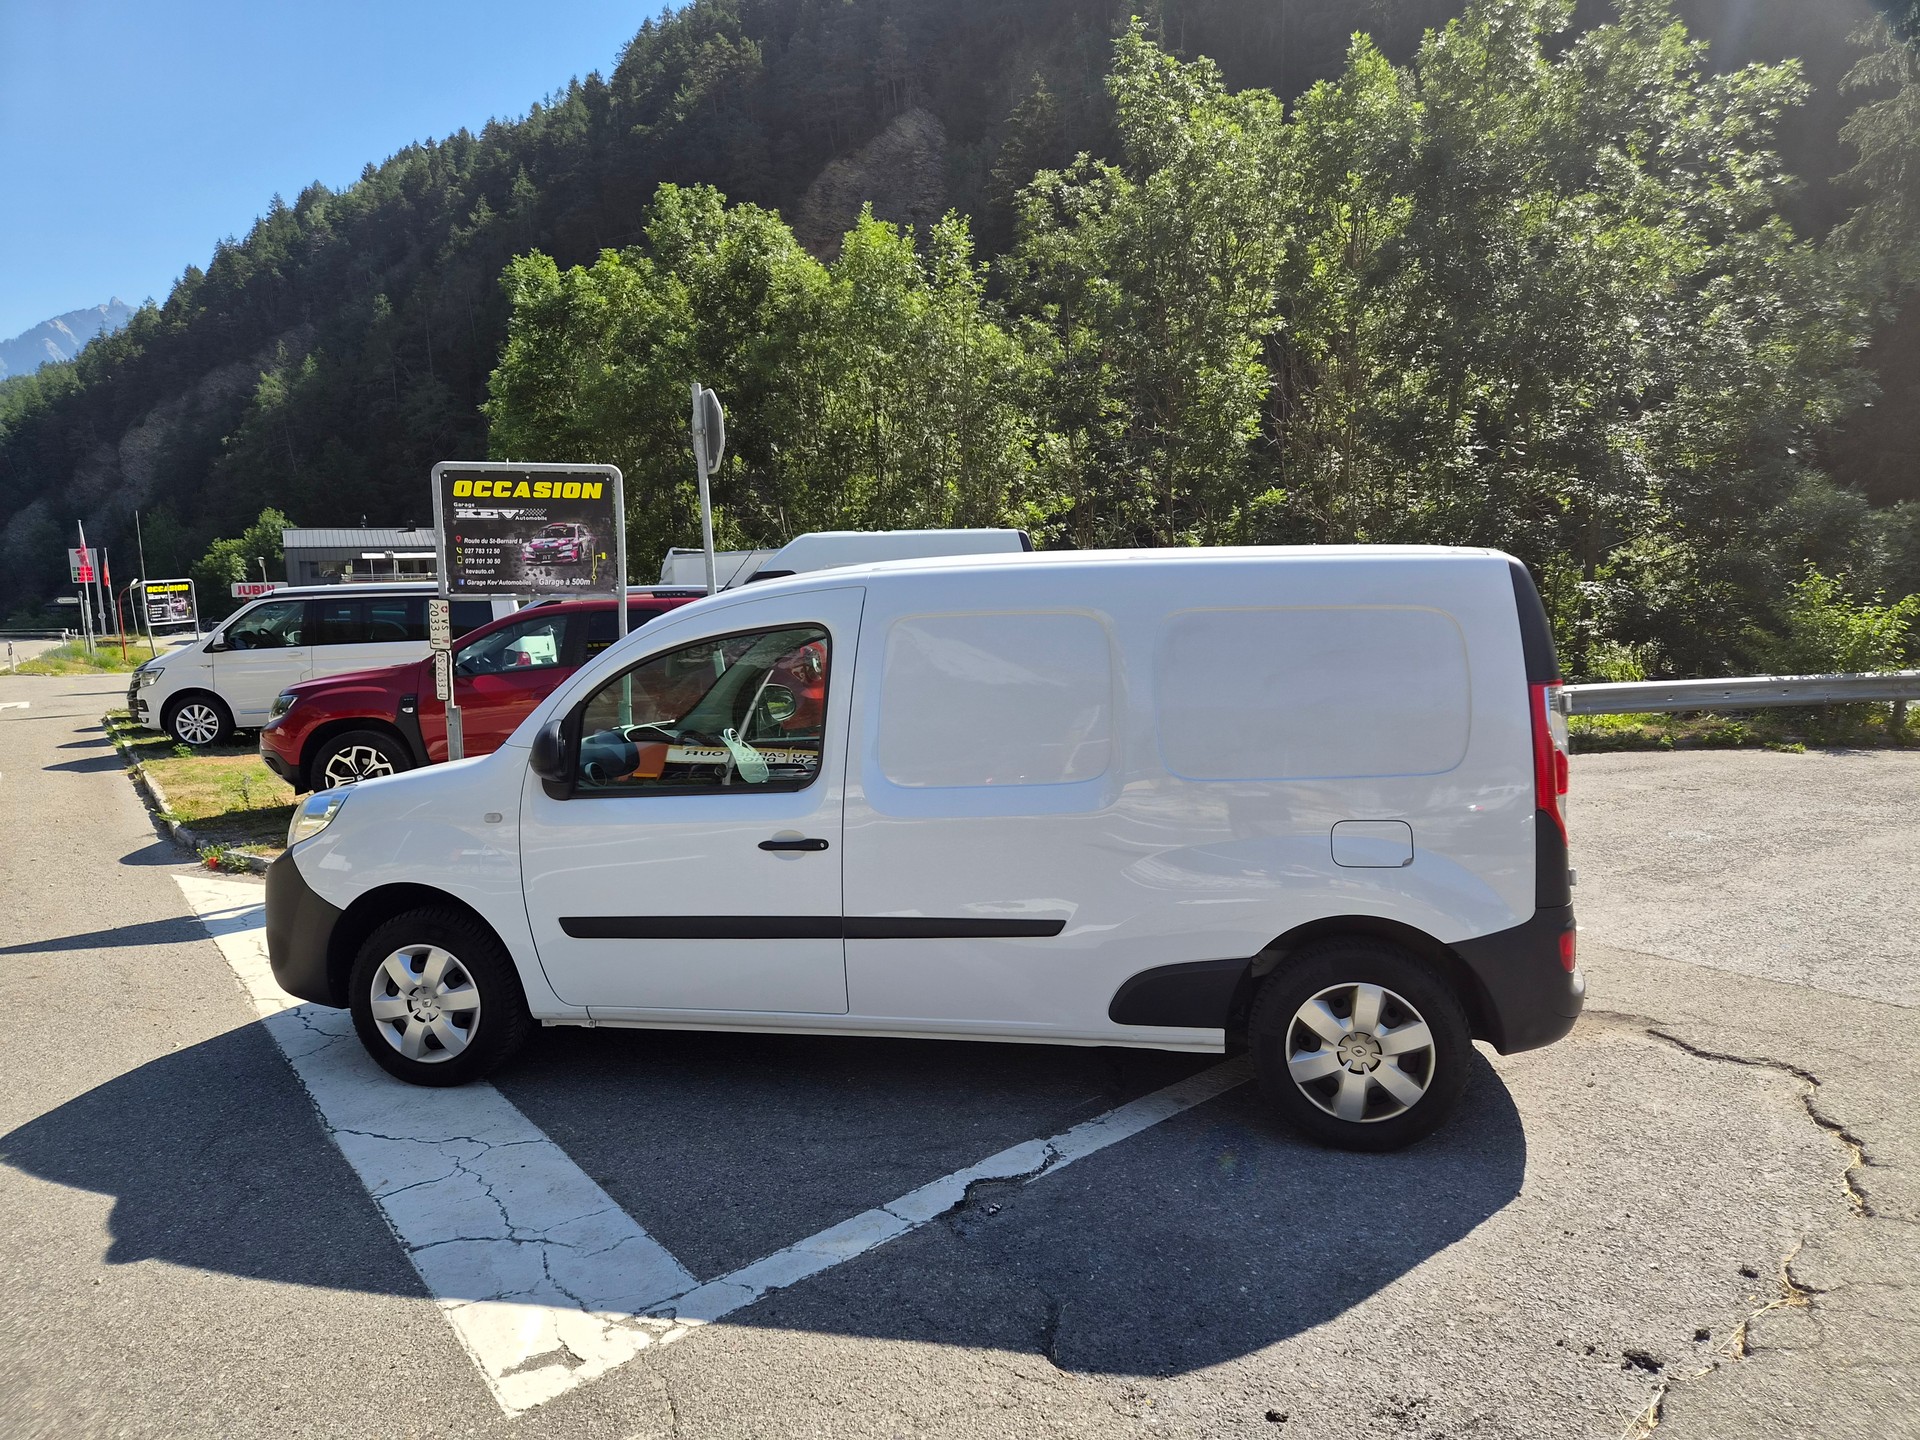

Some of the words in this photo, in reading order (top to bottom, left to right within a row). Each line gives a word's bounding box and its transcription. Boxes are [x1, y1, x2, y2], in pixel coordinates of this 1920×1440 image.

[452, 480, 603, 499] OCCASION
[538, 578, 564, 587] Garage
[565, 578, 570, 586] à
[441, 618, 449, 631] VS
